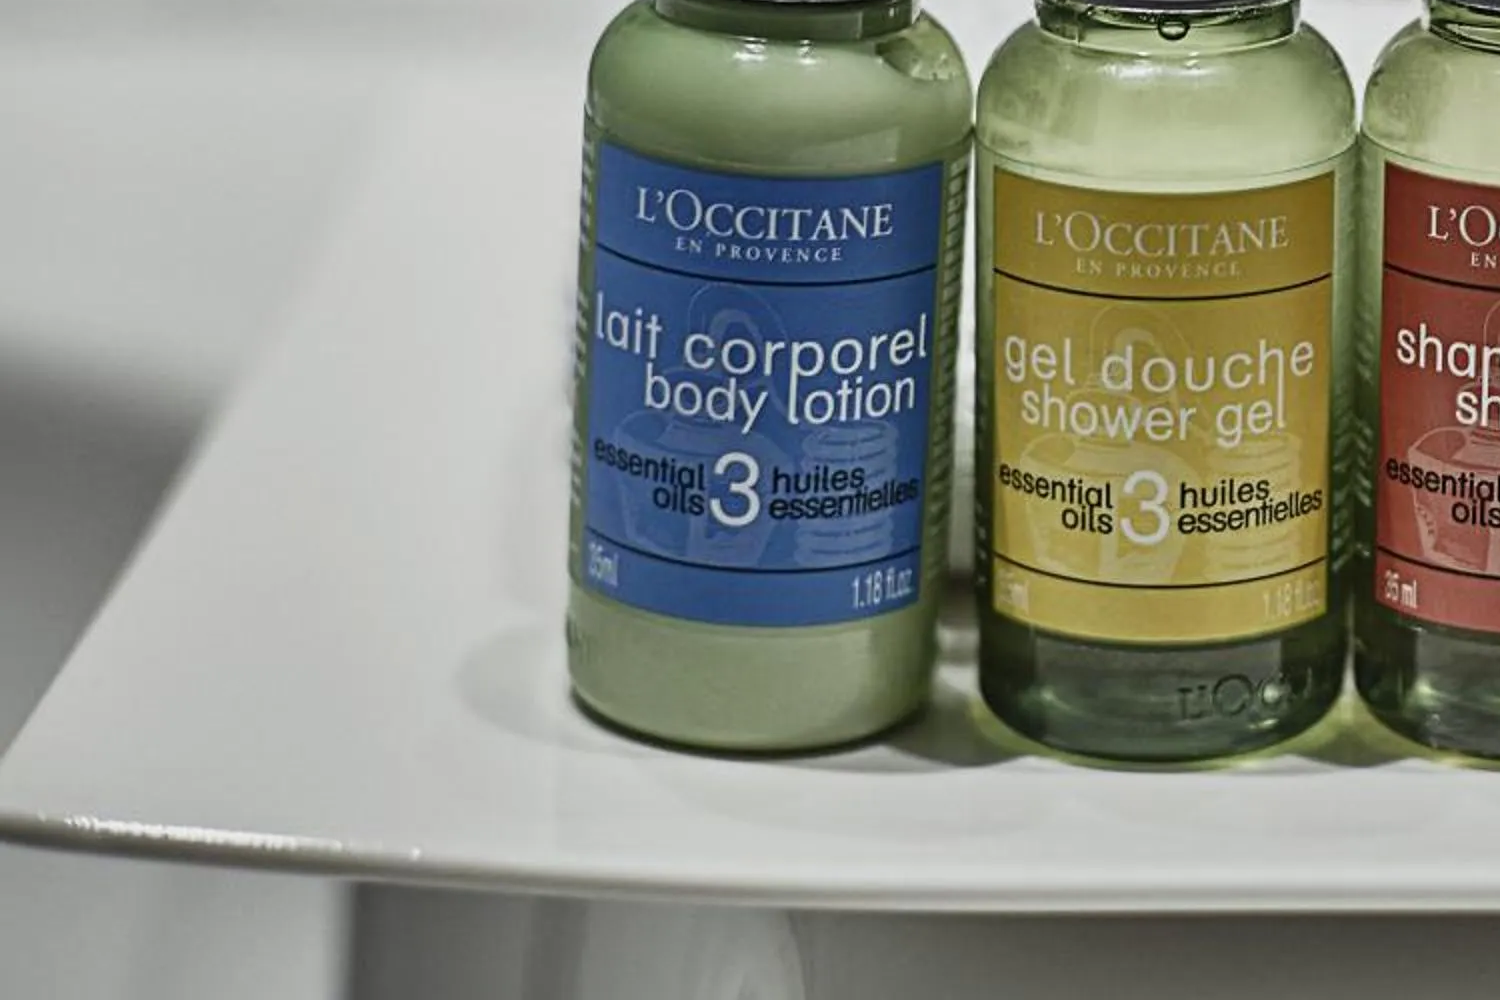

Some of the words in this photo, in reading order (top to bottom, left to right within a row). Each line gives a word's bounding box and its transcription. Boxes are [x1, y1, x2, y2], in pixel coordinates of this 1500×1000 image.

[636, 187, 894, 241] L'OCCITANE
[1036, 211, 1290, 257] L'OCCITANE
[676, 237, 702, 253] EN
[715, 243, 843, 263] PROVENCE
[1076, 257, 1103, 274] EN
[1116, 261, 1241, 279] PROVENCE
[1471, 252, 1497, 268] EN
[596, 290, 662, 359] lait
[684, 313, 927, 392] corporel
[1004, 335, 1075, 384] gel
[1101, 339, 1314, 393] douche
[645, 363, 768, 435] body
[787, 372, 915, 425] lotion
[1021, 384, 1197, 441] shower
[1215, 384, 1286, 448] gel
[594, 438, 706, 491] essential
[772, 465, 866, 494] huiles
[999, 463, 1113, 509] essential
[653, 484, 705, 516] oils
[710, 451, 761, 527] 3
[768, 478, 919, 520] essentielles
[1120, 469, 1170, 546] 3
[1177, 488, 1324, 535] essentielles
[1179, 478, 1270, 510] huiles
[1061, 503, 1113, 535] oils
[851, 569, 883, 610] 1.18
